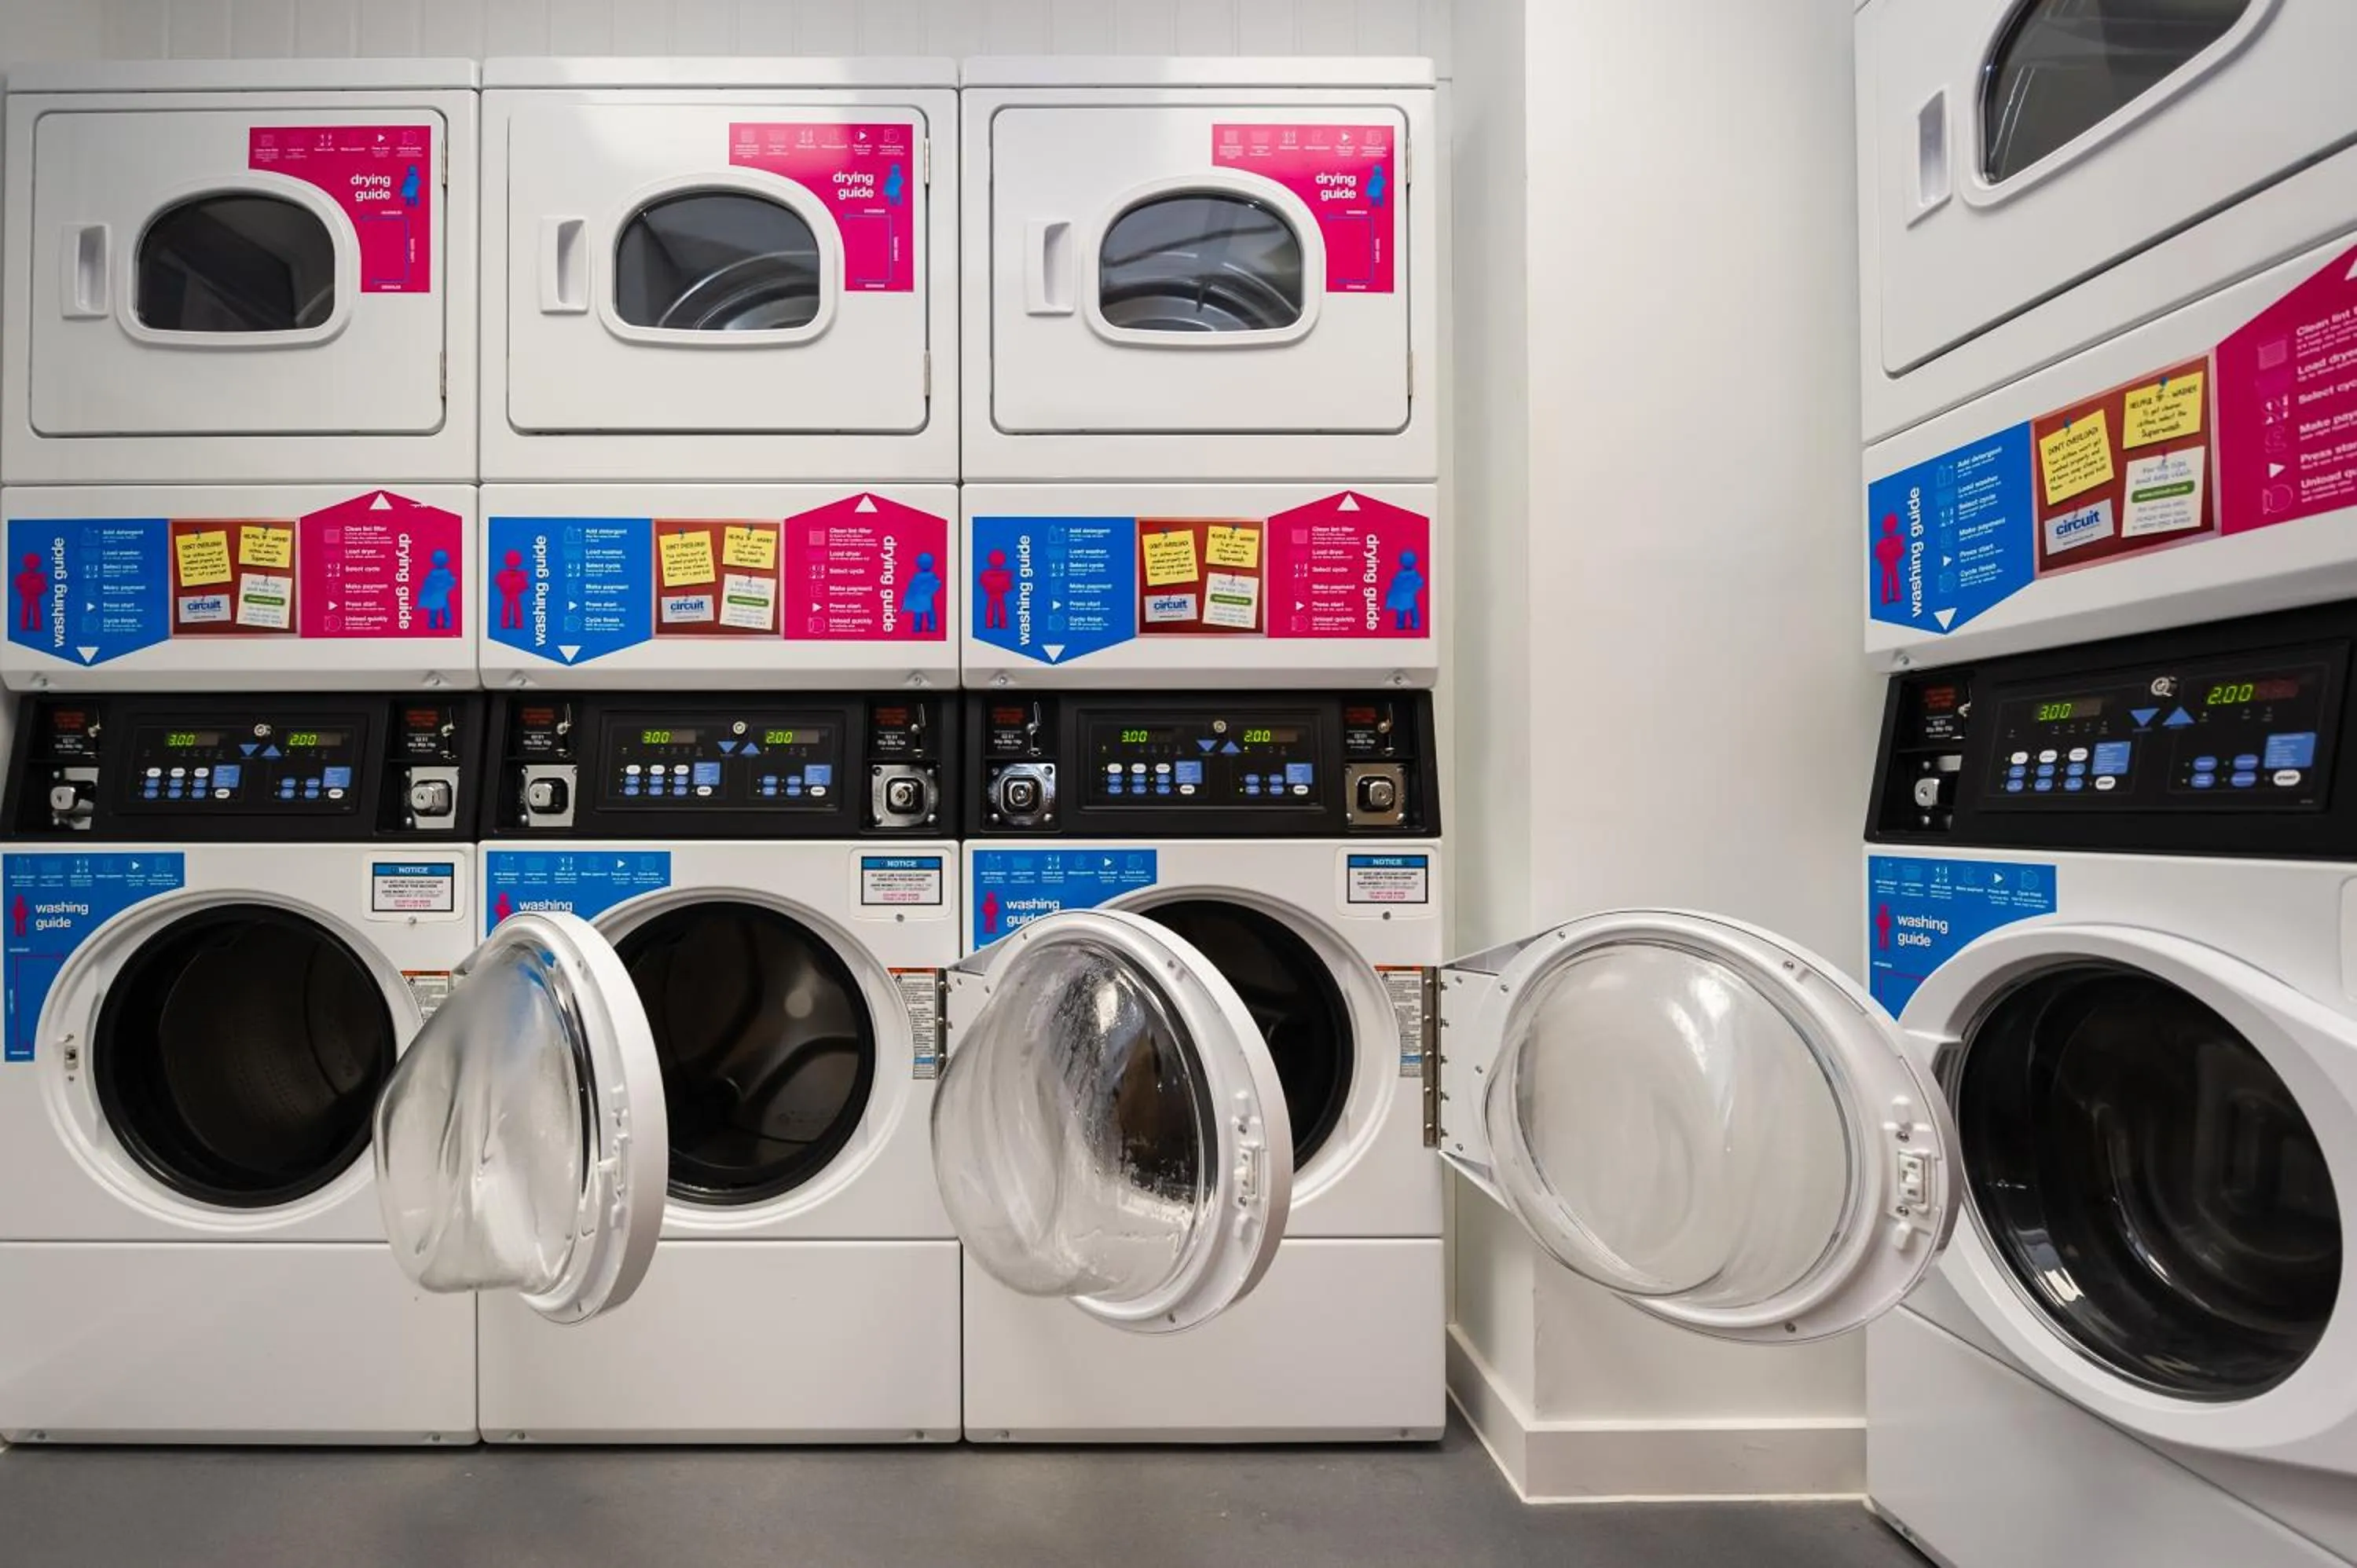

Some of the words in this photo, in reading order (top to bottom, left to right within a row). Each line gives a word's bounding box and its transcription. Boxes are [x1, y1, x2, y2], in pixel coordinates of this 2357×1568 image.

[350, 174, 391, 187] drying
[833, 171, 874, 185] drying
[1315, 173, 1357, 186] drying
[355, 189, 391, 202] guide
[838, 187, 874, 200] guide
[1321, 189, 1357, 201] guide
[2297, 318, 2329, 336] Clean
[2331, 310, 2350, 324] lint
[2297, 358, 2326, 375] Load
[2298, 385, 2334, 405] Select
[2300, 419, 2331, 433] Make
[2300, 449, 2333, 463] Press
[2300, 471, 2341, 489] Unload
[1908, 486, 1923, 537] guide
[2056, 510, 2100, 535] circuit
[51, 537, 68, 580] guide
[396, 533, 412, 582] drying
[533, 536, 549, 578] guide
[880, 535, 897, 585] drying
[1017, 535, 1033, 577] guide
[1364, 534, 1380, 583] drying
[1909, 541, 1923, 618] washing
[188, 599, 222, 610] circuit
[396, 586, 412, 629] guide
[670, 599, 704, 610] circuit
[880, 589, 897, 632] guide
[1017, 581, 1033, 645] washing
[1154, 599, 1188, 610] circuit
[1364, 587, 1380, 630] guide
[51, 584, 68, 647] washing
[533, 582, 549, 647] washing
[2207, 684, 2254, 705] 2.00
[35, 901, 89, 915] washing
[519, 899, 573, 911] washing
[1006, 898, 1060, 912] washing
[35, 917, 71, 930] guide
[1006, 912, 1036, 927] guid
[1897, 914, 1949, 934] washing
[1897, 932, 1931, 947] guide
